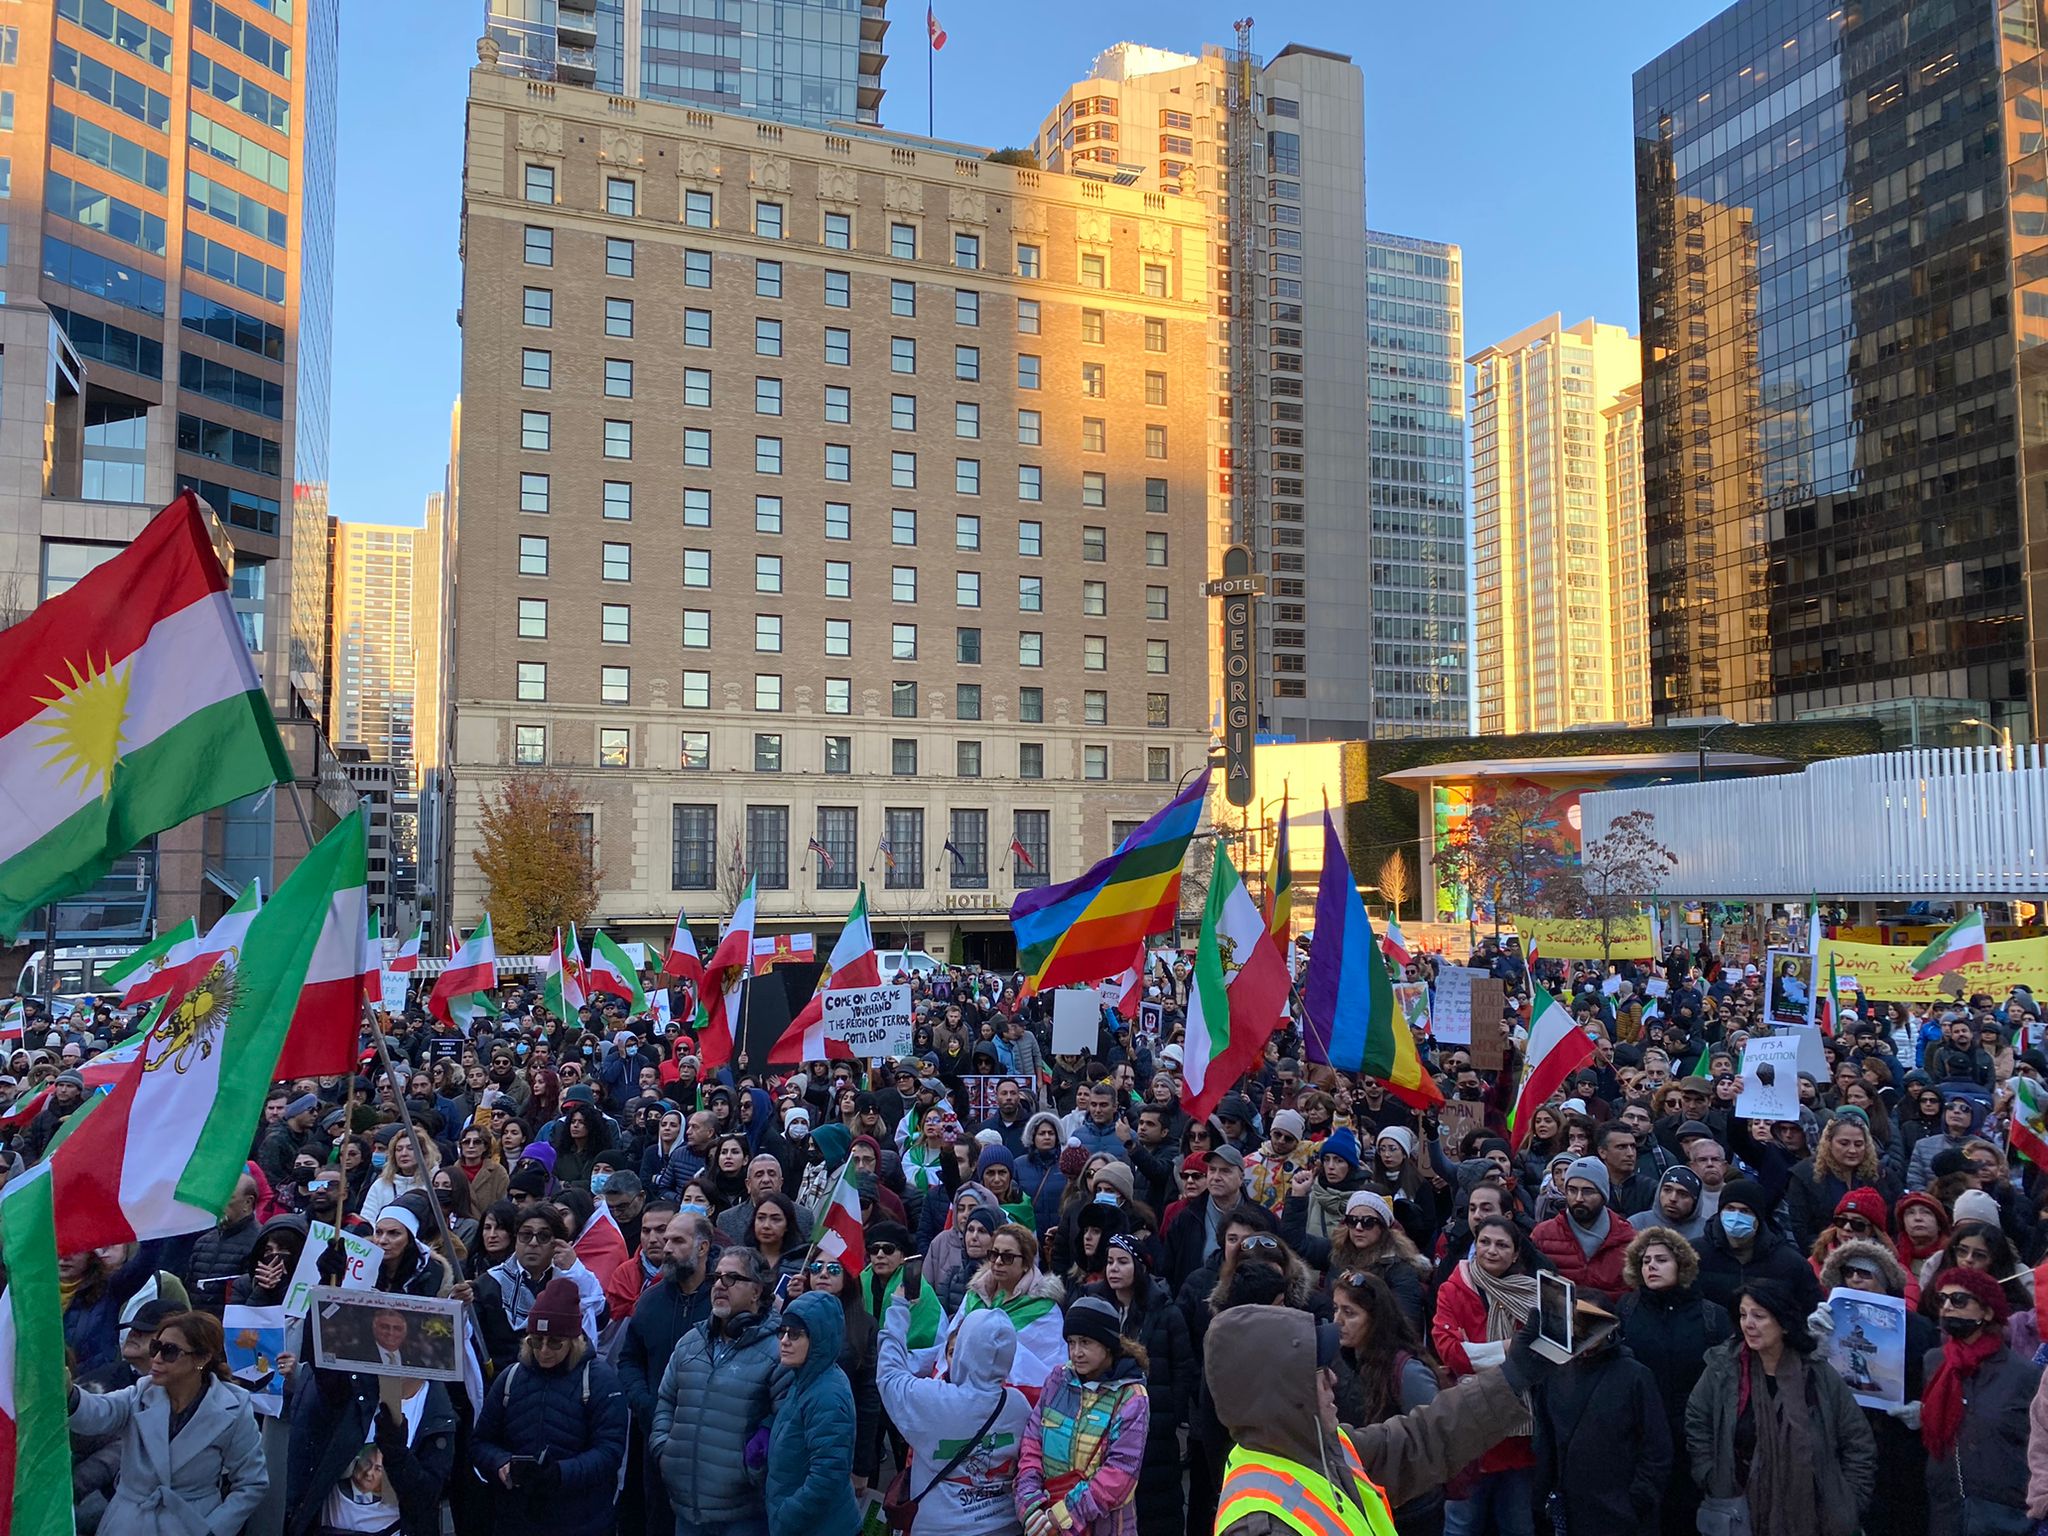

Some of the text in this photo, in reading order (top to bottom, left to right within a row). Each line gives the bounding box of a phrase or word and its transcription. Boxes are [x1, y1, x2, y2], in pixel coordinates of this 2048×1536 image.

[1213, 578, 1259, 593] HOTEL
[1227, 603, 1249, 780] GEORGIA
[945, 894, 1001, 908] HOTEL
[1521, 930, 1541, 942] Oe
[1824, 952, 1880, 974] Down
[825, 989, 901, 1011] COME ON GIVE ME
[828, 1014, 911, 1031] THE REIGN OF TERROR
[843, 1031, 867, 1045] GOTTA
[869, 1028, 887, 1043] END
[1777, 1040, 1783, 1049] A
[1745, 1051, 1796, 1062] REVOLUTION
[312, 1222, 373, 1258] WMEN
